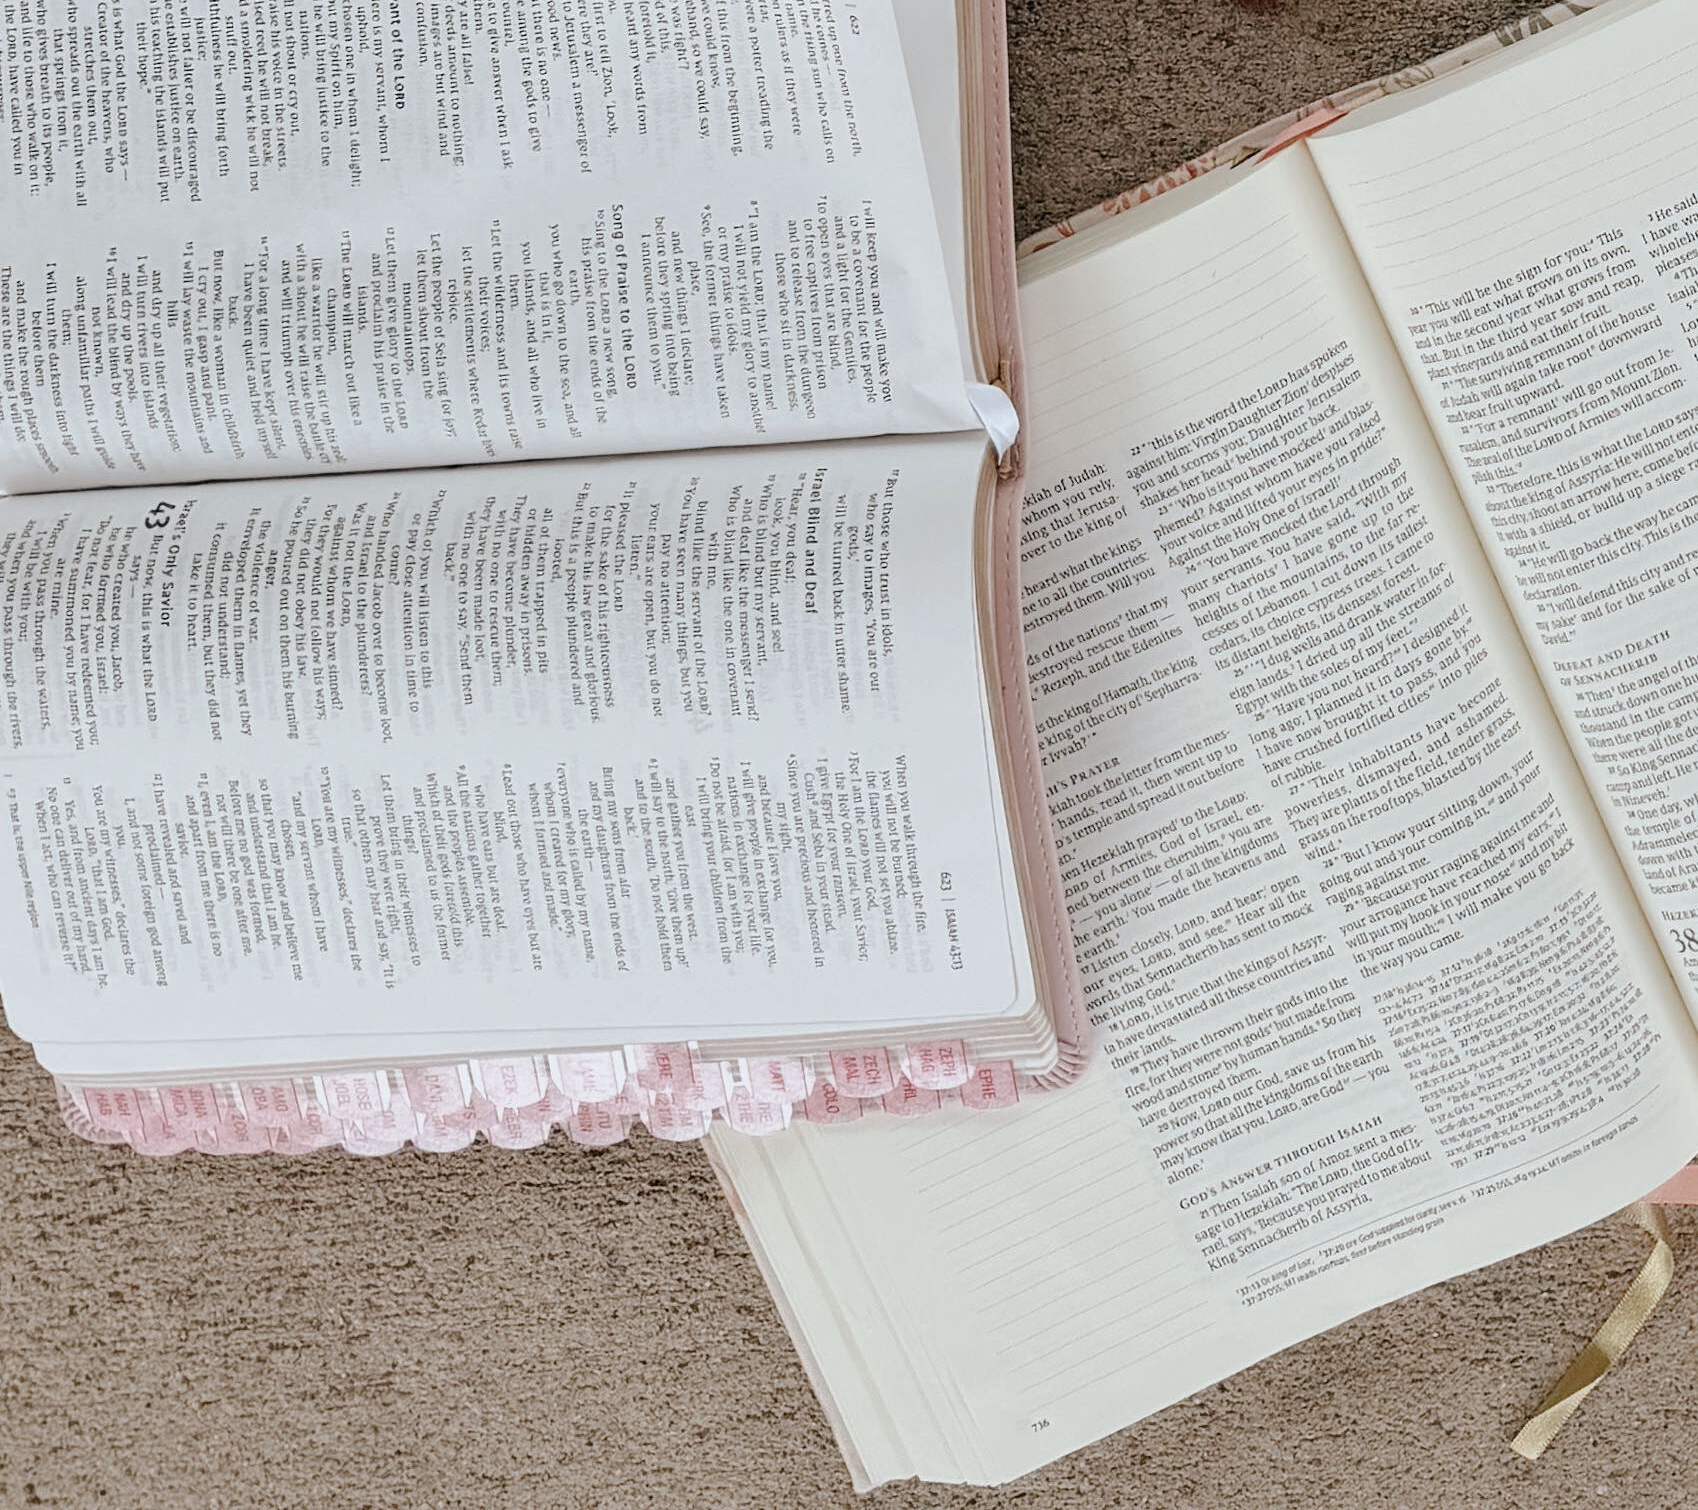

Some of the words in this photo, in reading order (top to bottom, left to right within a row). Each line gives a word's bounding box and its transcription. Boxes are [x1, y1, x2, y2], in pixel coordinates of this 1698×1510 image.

[390, 28, 403, 43] of
[848, 14, 860, 35] 622
[391, 47, 405, 71] the
[393, 75, 405, 110] LORD
[610, 203, 624, 239] Song
[614, 243, 627, 258] of
[615, 262, 630, 304] Praise
[619, 308, 630, 324] to
[620, 327, 634, 351] the
[623, 354, 637, 389] LORD
[144, 500, 176, 529] 43
[939, 871, 952, 891] 623
[944, 908, 959, 942] ISAIAH
[948, 944, 963, 970] 43:13
[1220, 1161, 1273, 1190] ANSWER
[1272, 1133, 1336, 1167] THROUGH
[1336, 1115, 1382, 1140] ISAIAH
